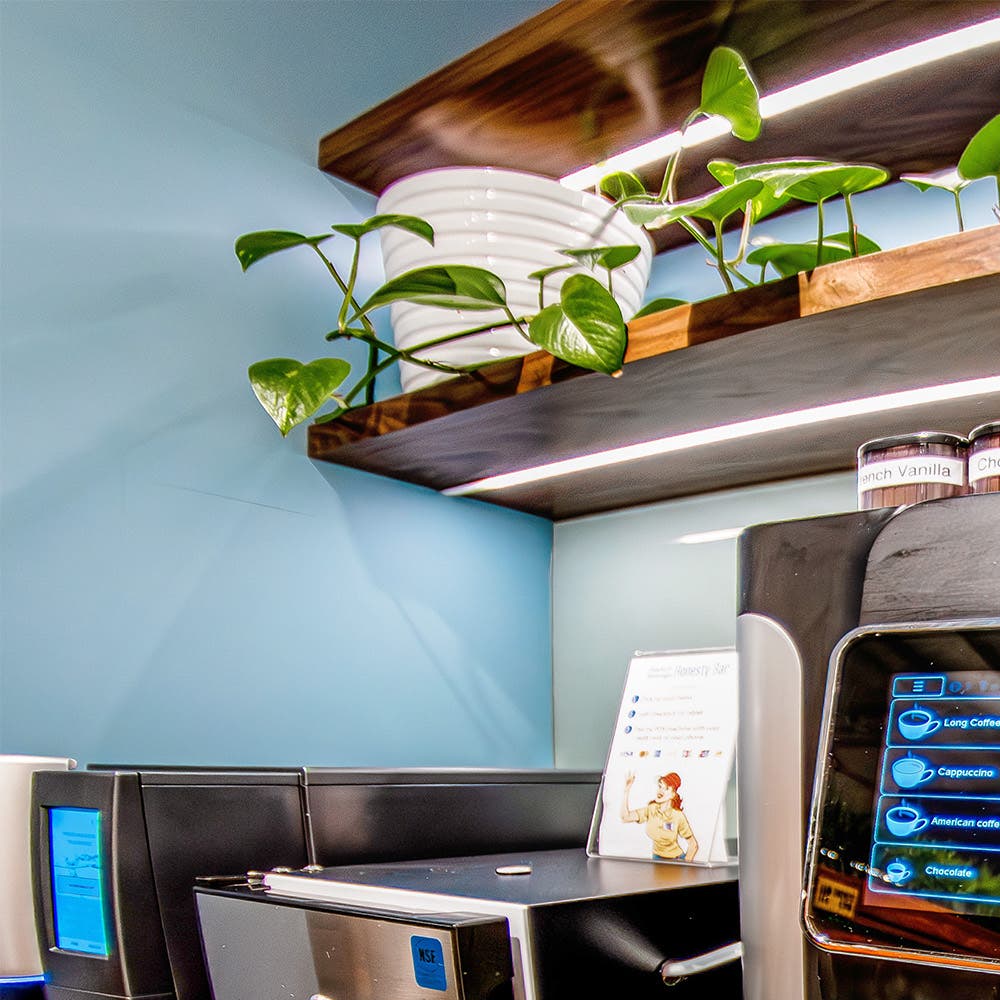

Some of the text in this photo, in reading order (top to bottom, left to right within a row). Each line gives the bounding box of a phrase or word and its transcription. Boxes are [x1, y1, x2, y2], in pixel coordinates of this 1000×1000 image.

[861, 463, 951, 484] ench Vanilla
[943, 718, 967, 729] Long
[937, 767, 993, 778] Cappuccino
[930, 817, 975, 827] American
[925, 866, 973, 877] Chocolate
